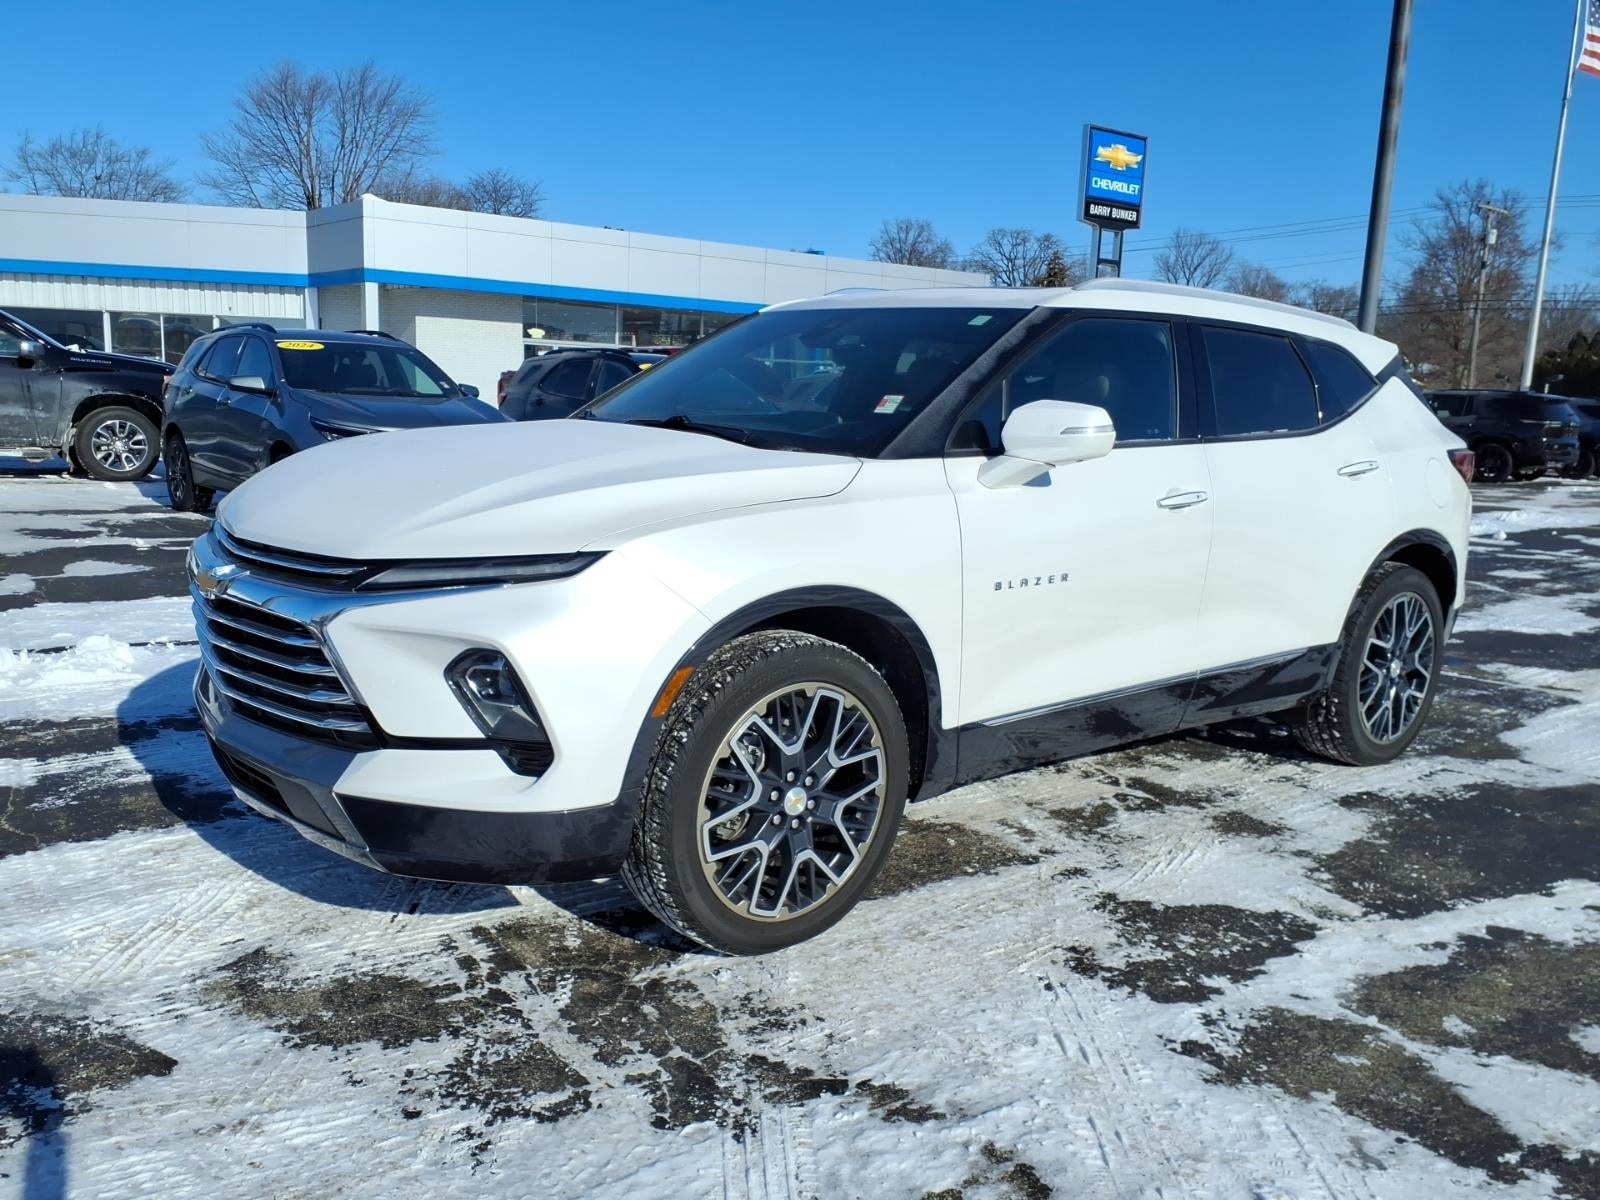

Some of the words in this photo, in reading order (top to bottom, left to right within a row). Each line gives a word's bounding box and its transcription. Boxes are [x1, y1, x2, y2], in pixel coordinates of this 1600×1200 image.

[1091, 176, 1140, 195] CHEVROLET
[1089, 203, 1111, 217] BARRY
[1111, 207, 1137, 222] BUNKER
[994, 573, 1069, 591] BLAZER
